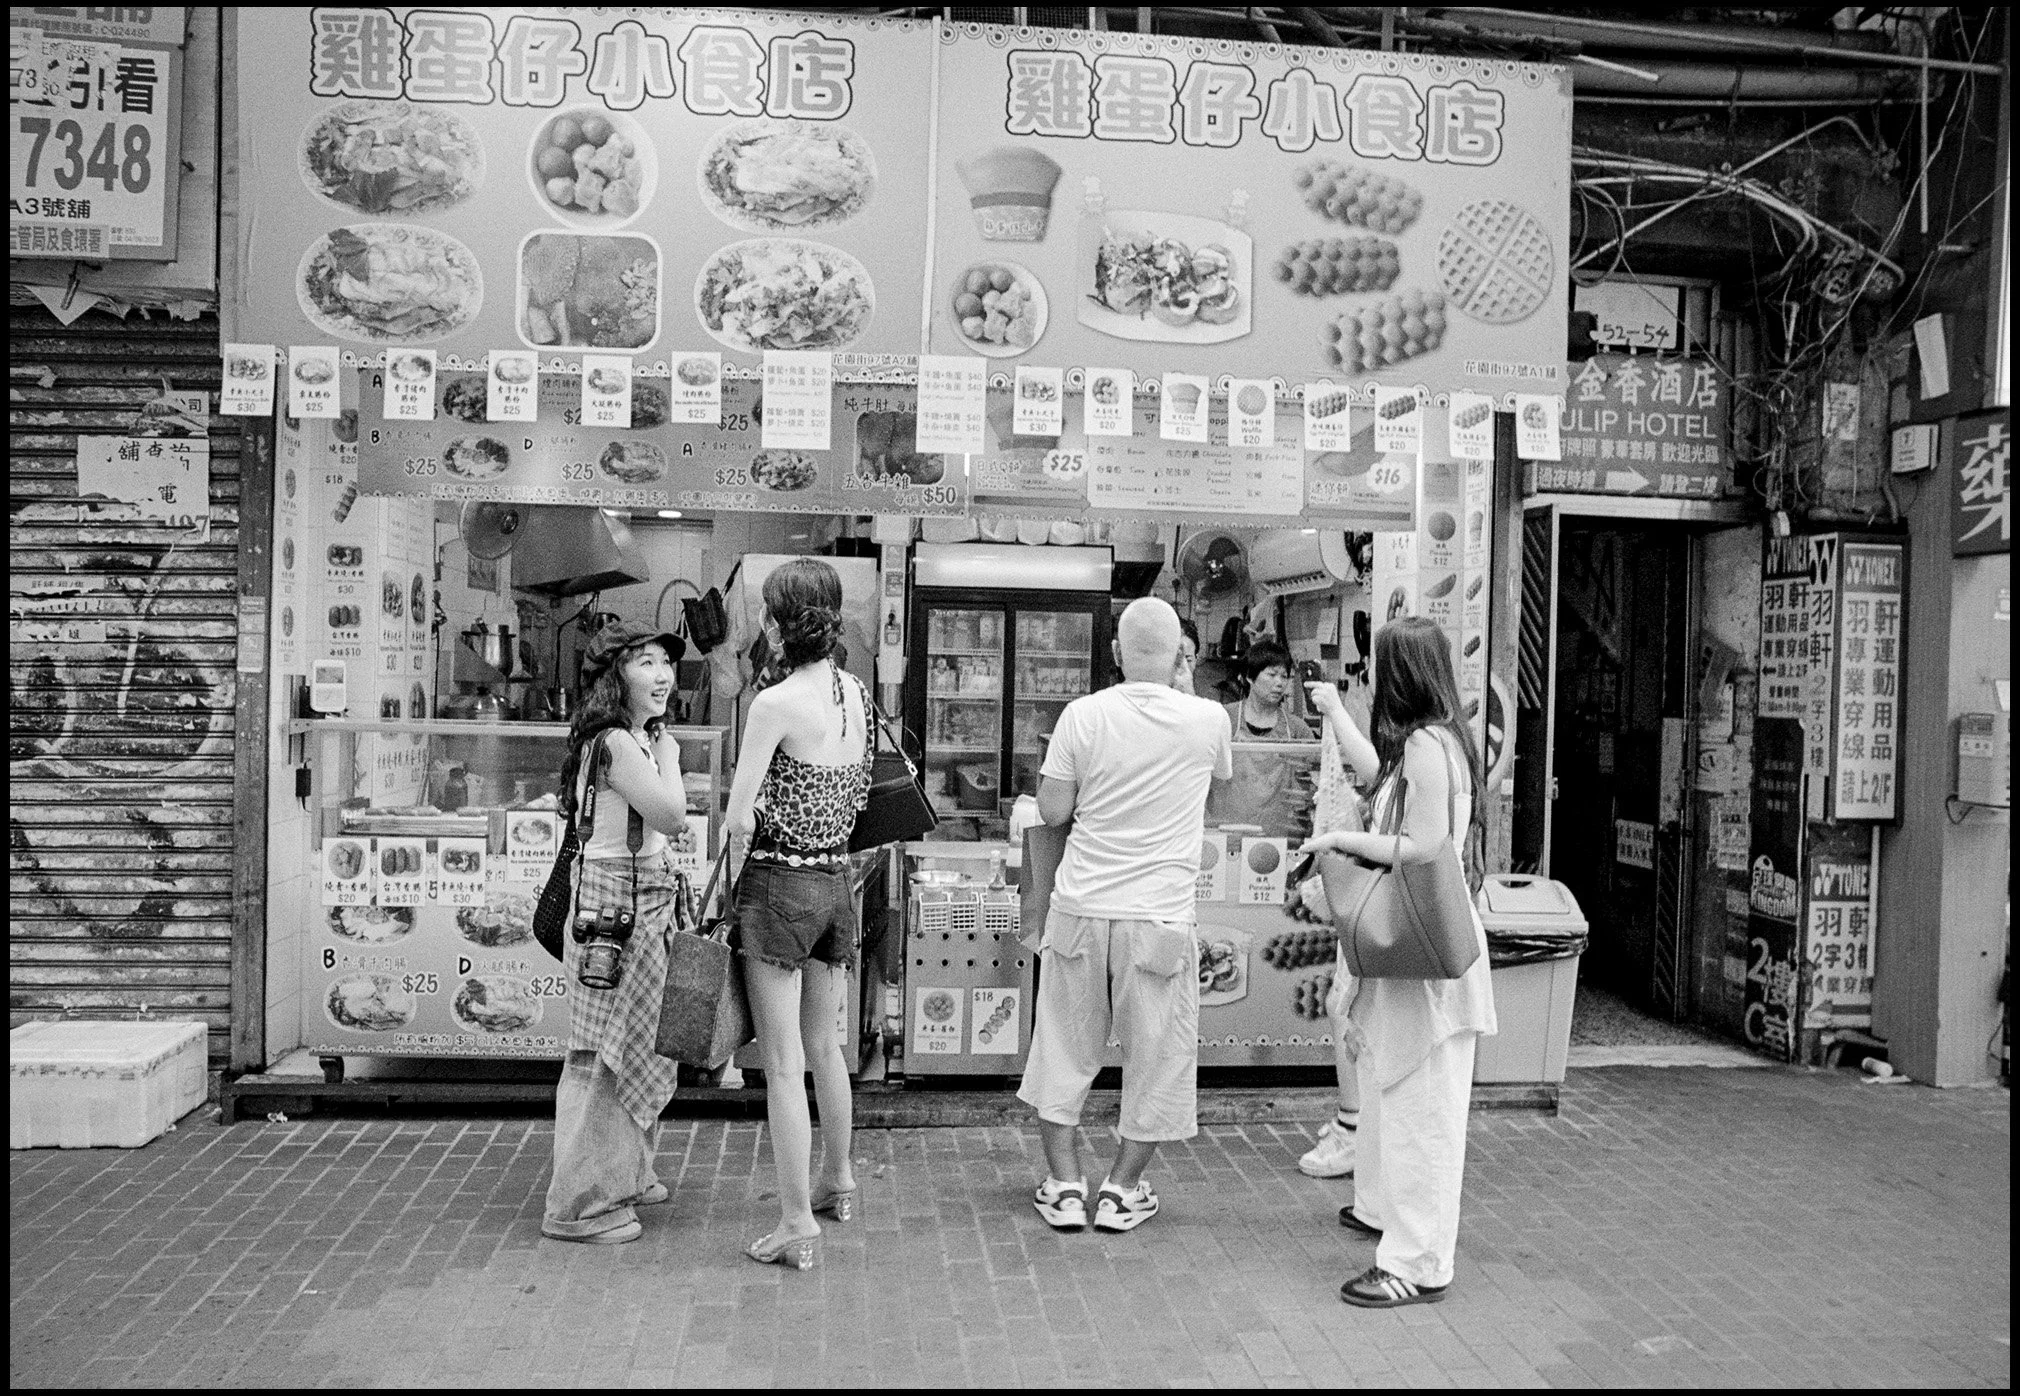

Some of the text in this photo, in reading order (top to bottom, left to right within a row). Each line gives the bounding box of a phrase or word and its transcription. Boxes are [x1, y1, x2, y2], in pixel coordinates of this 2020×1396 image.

[310, 8, 855, 119] 雞蛋仔小食店
[1005, 49, 1505, 165] 雞蛋仔小食店
[20, 116, 151, 193] 7348
[372, 374, 383, 388] A
[1574, 356, 1718, 409] 金香酒店
[237, 402, 256, 412] $30
[306, 402, 323, 411] $25
[399, 405, 418, 415] $25
[503, 405, 521, 415] $25
[597, 411, 615, 421] $25
[687, 409, 706, 419] $25
[1029, 423, 1047, 432] $30
[1560, 409, 1718, 438] ULIP HOTEL
[371, 430, 381, 443] B
[1243, 435, 1260, 444] $20
[1320, 439, 1336, 447] $20
[1390, 441, 1406, 449] $20
[683, 443, 693, 456] A
[405, 458, 437, 475] $25
[1050, 454, 1083, 472] $25
[562, 463, 594, 480] $25
[715, 469, 747, 485] $25
[1374, 468, 1400, 485] $16
[326, 475, 343, 484] $18
[924, 486, 956, 504] $50
[338, 585, 354, 594] $30
[1846, 599, 1898, 635] 羽軒
[345, 648, 361, 657] $10
[584, 785, 595, 817] Canon
[523, 868, 541, 877] $25
[338, 894, 356, 903] $20
[402, 894, 420, 903] $10
[453, 894, 471, 903] $30
[1254, 892, 1270, 900] $12
[324, 950, 336, 968] B
[459, 957, 471, 974] D
[402, 974, 438, 993] $25
[531, 977, 567, 996] $25
[975, 992, 993, 1001] $18
[930, 1041, 946, 1050] $20
